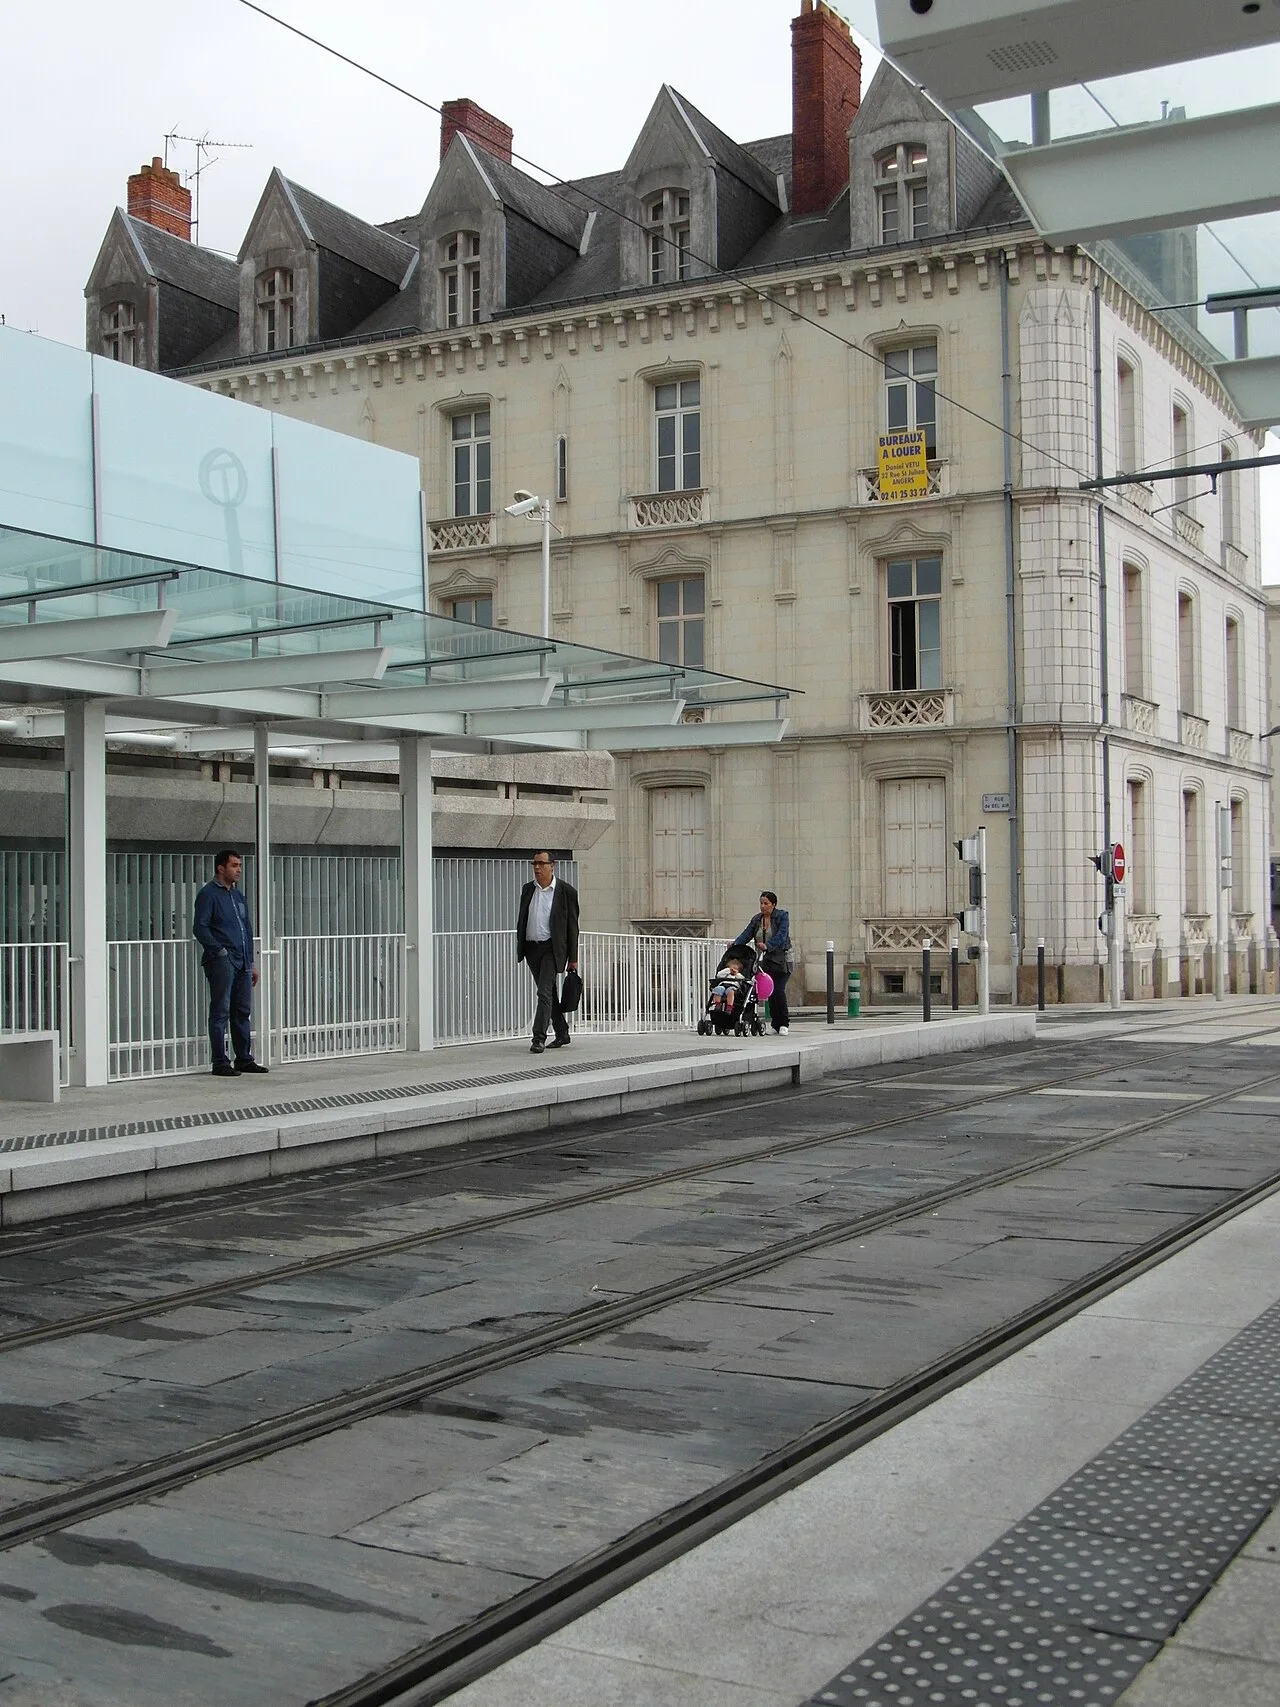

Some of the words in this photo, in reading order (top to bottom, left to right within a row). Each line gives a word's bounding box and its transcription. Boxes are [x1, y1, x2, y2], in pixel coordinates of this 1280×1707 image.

[879, 432, 923, 447] BUREAUX
[882, 449, 889, 459] A
[891, 445, 921, 458] LOUER
[885, 463, 904, 471] Daniel
[892, 477, 915, 485] ANGERS
[881, 491, 889, 500] 02
[890, 490, 898, 499] 41
[900, 489, 908, 498] 25
[910, 488, 918, 497] 33
[919, 487, 927, 496] 22
